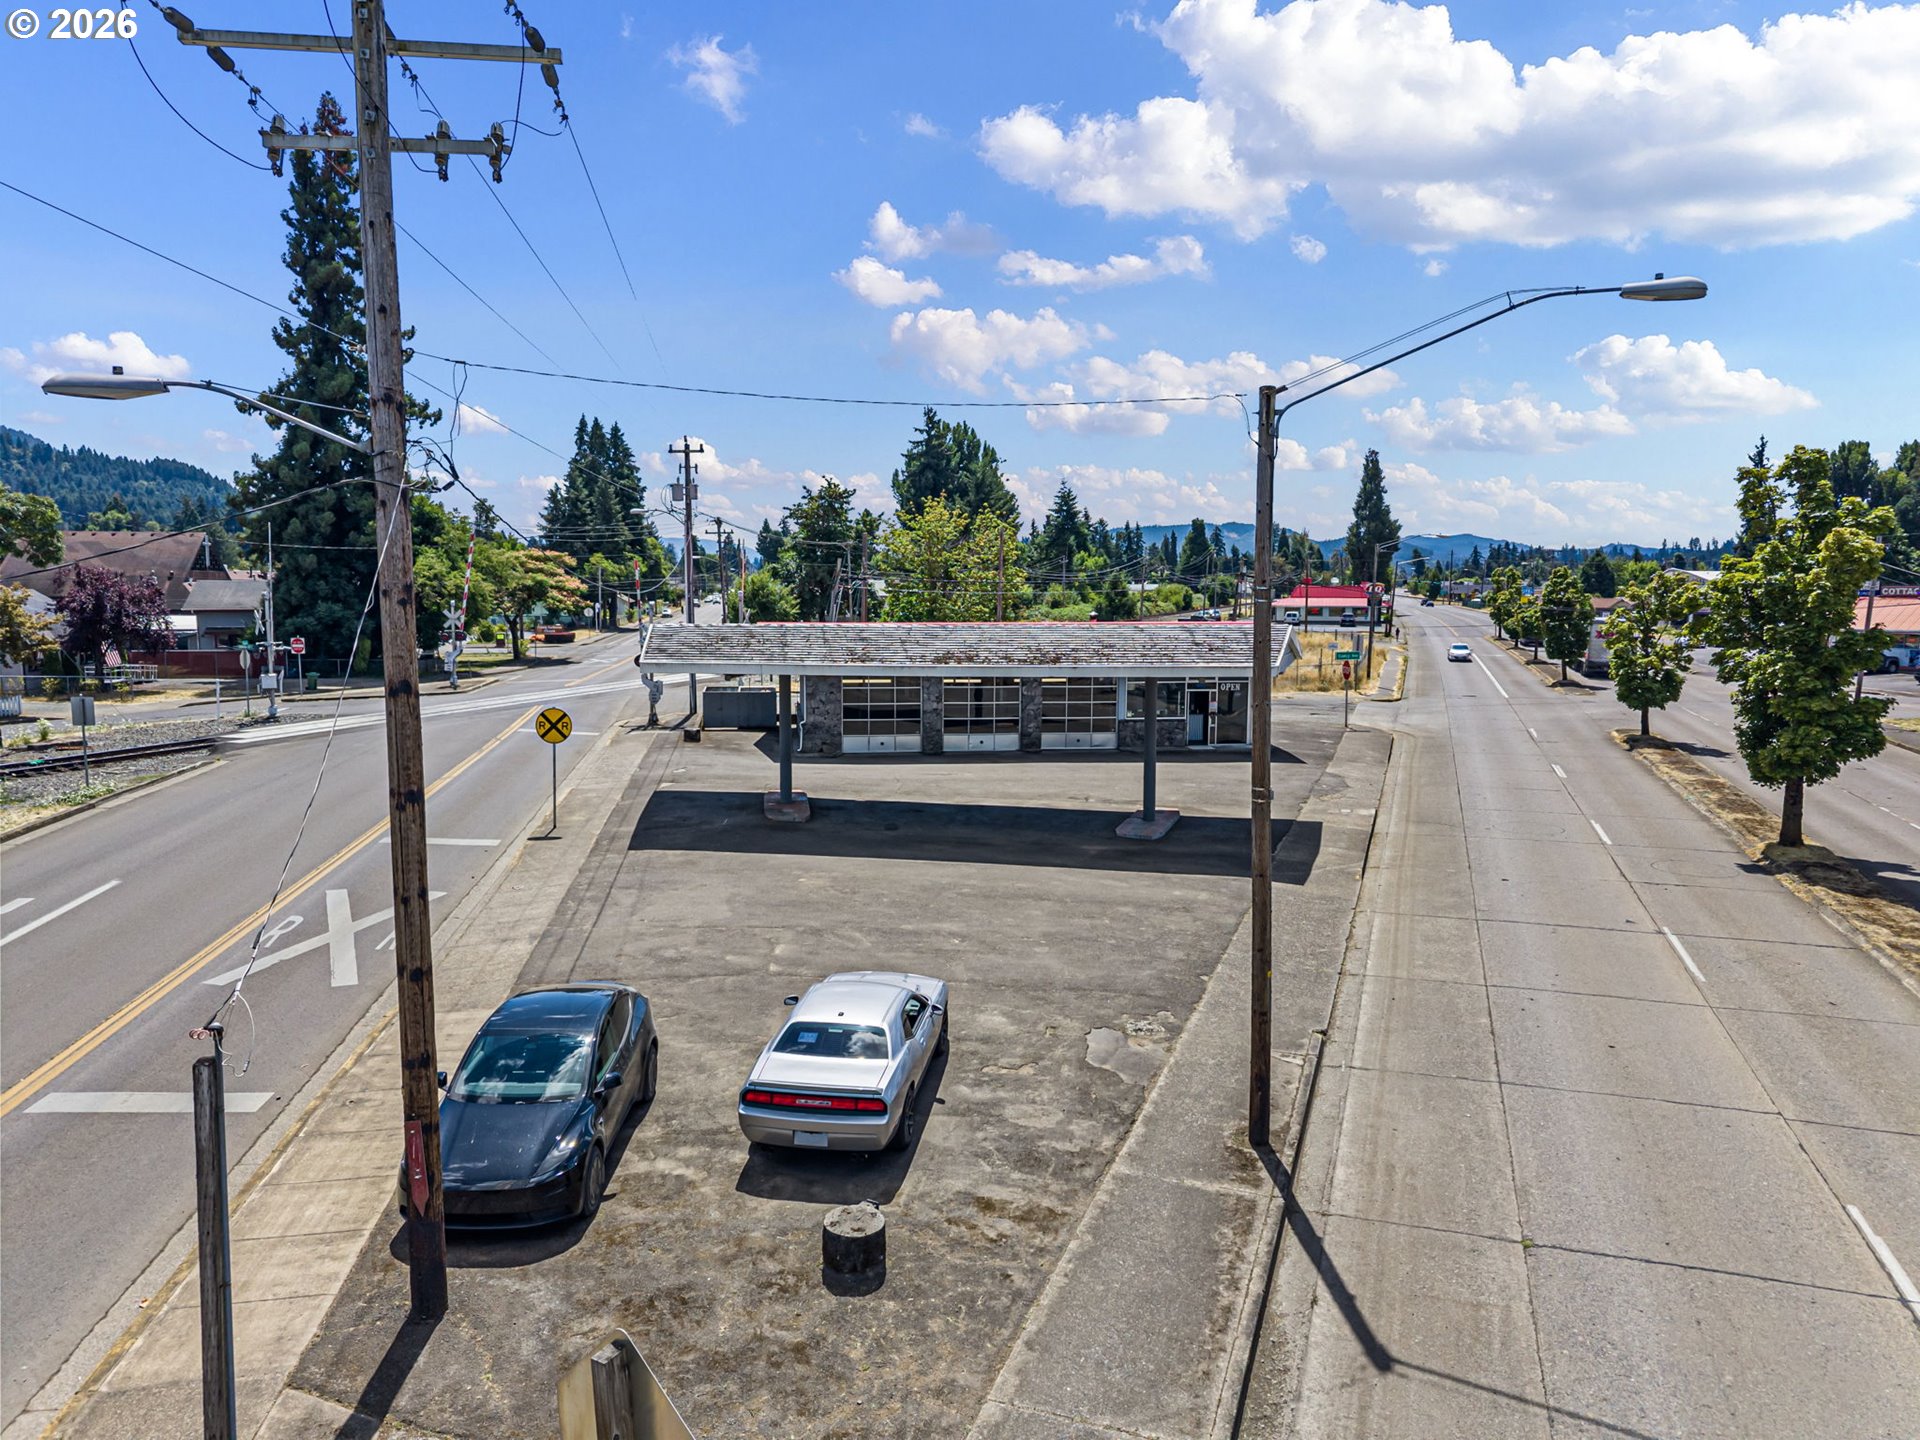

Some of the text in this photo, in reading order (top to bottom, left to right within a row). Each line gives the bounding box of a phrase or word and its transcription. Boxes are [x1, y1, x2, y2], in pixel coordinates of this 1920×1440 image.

[1220, 683, 1241, 691] OPEN
[538, 721, 569, 730] R R
